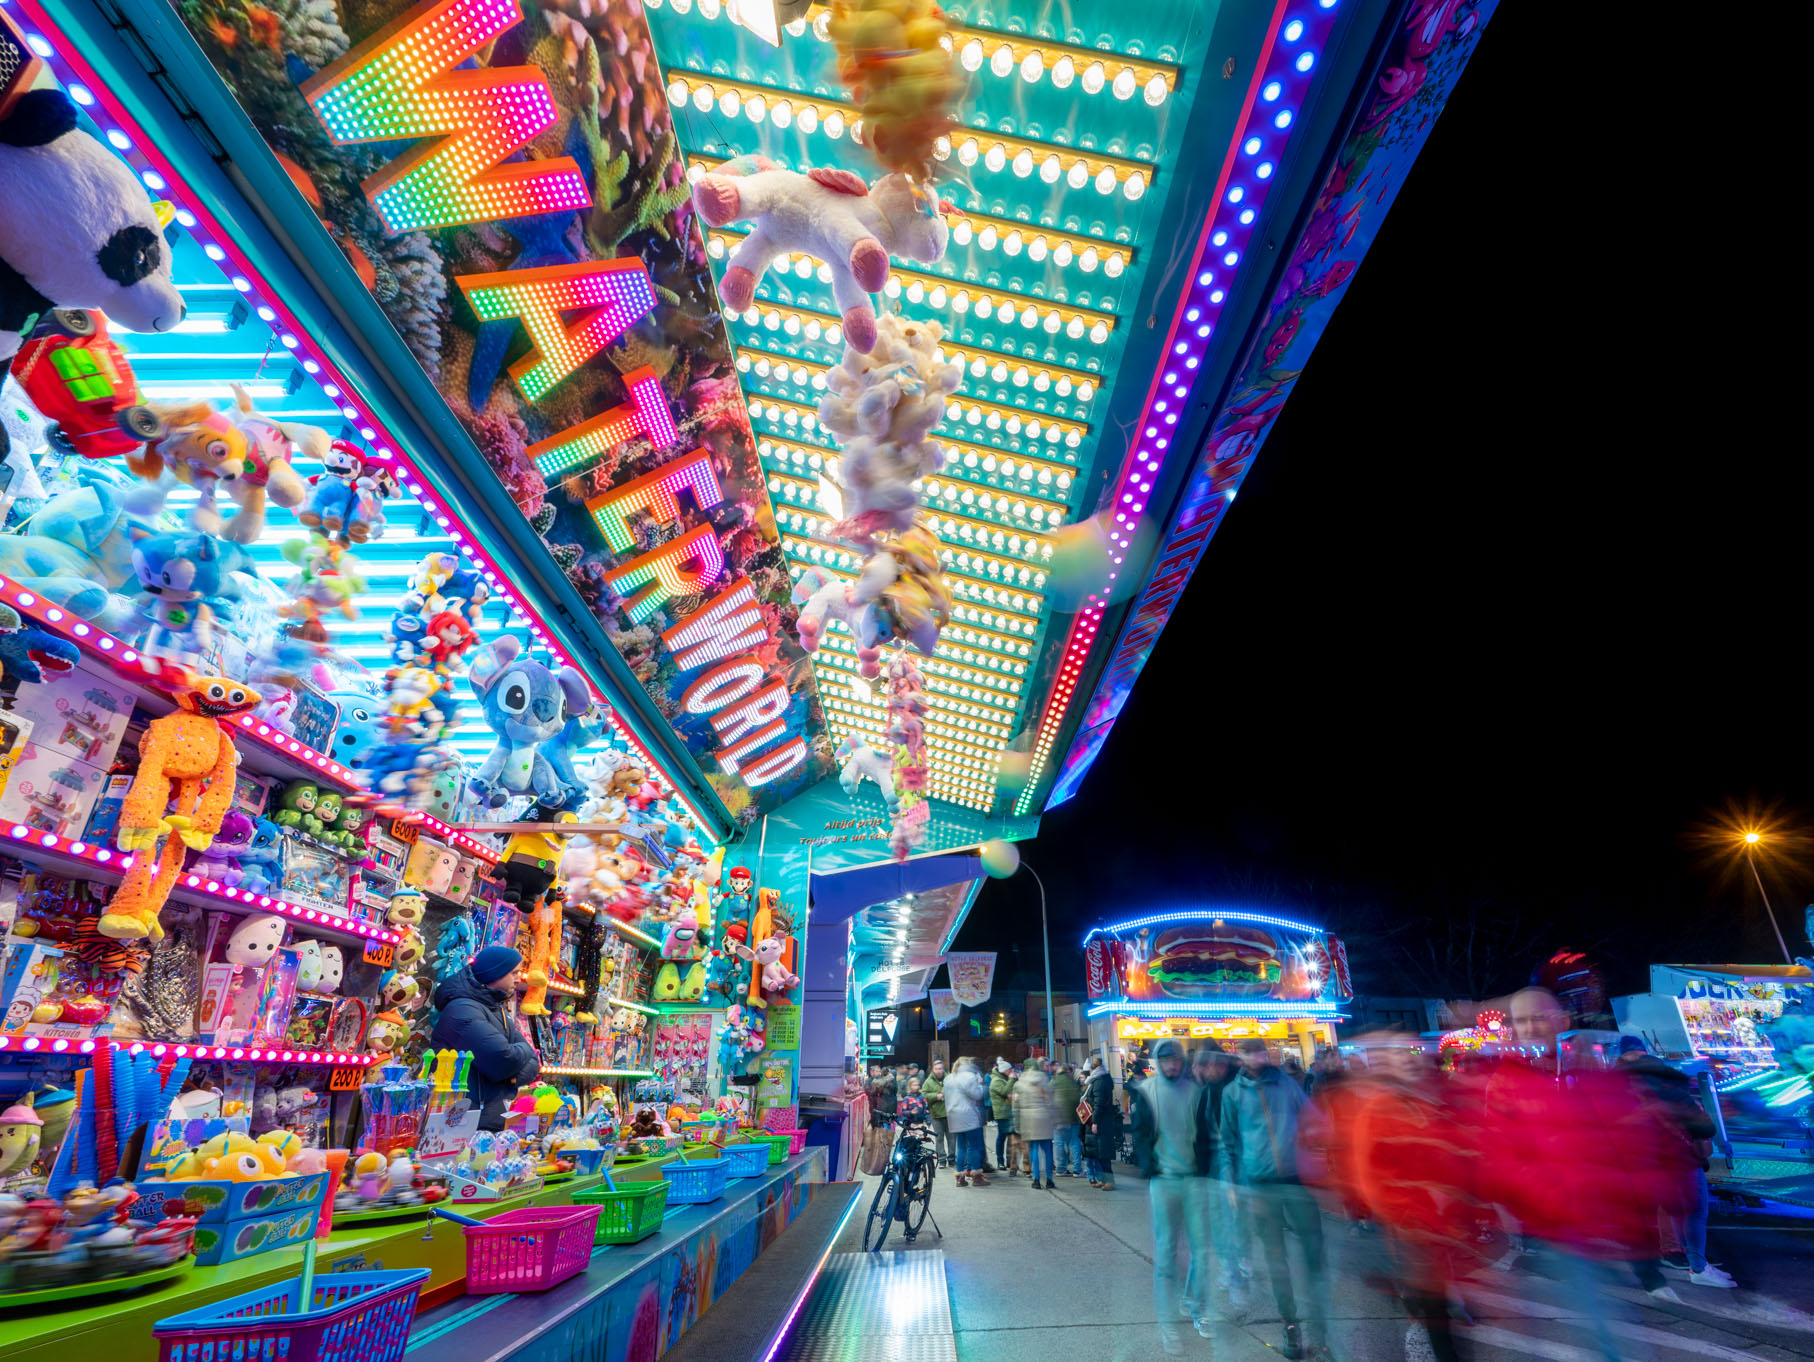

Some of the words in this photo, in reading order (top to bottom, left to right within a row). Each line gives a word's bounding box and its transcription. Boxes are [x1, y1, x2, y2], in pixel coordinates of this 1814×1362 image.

[394, 820, 410, 838] 600
[823, 818, 855, 831] Altijd
[857, 816, 883, 830] prijs
[800, 835, 848, 847] Toujours
[851, 834, 866, 842] un
[366, 942, 383, 961] 400
[43, 1028, 81, 1038] KITCHEN
[333, 1069, 352, 1087] 200
